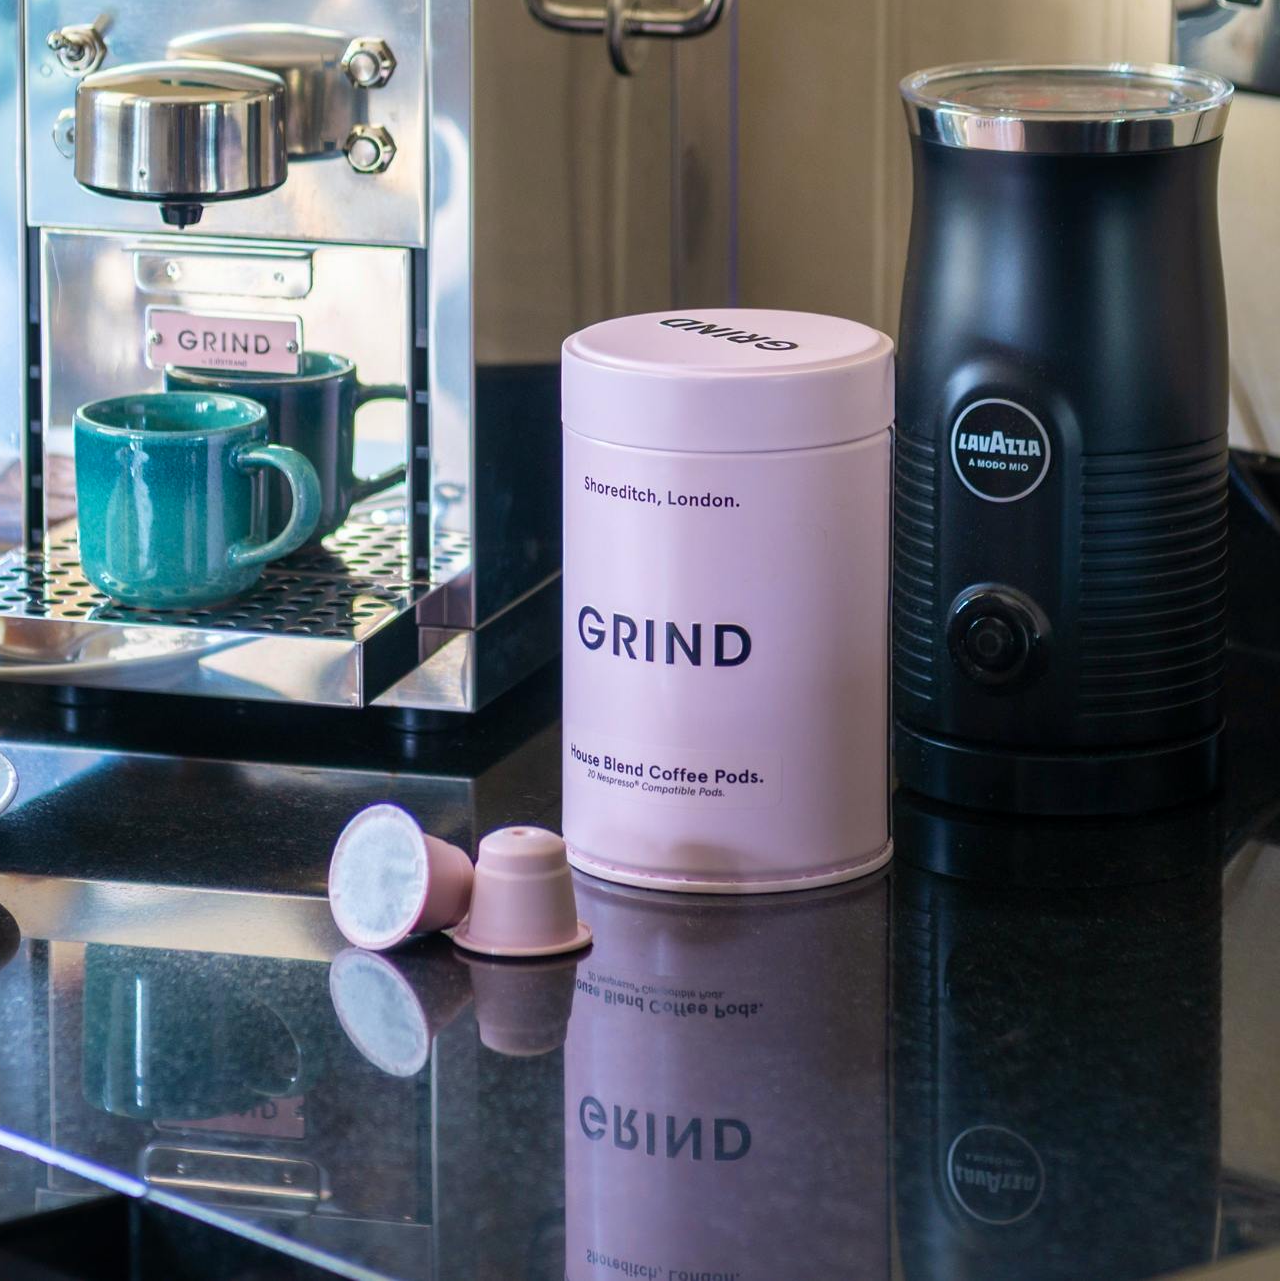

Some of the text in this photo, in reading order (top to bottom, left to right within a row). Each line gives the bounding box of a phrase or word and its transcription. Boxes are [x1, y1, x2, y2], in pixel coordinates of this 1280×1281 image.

[177, 330, 271, 355] GRIND
[659, 318, 799, 351] GRIND
[958, 430, 1041, 457] LAVAZZA
[968, 458, 1029, 472] A MODO MIO
[584, 476, 741, 508] Shoreditch, London.
[578, 605, 753, 668] GRIND
[570, 742, 764, 784] House Blend Coffee Pods.
[587, 768, 596, 779] 20
[641, 781, 696, 797] Compatible
[699, 786, 725, 798] Pods.
